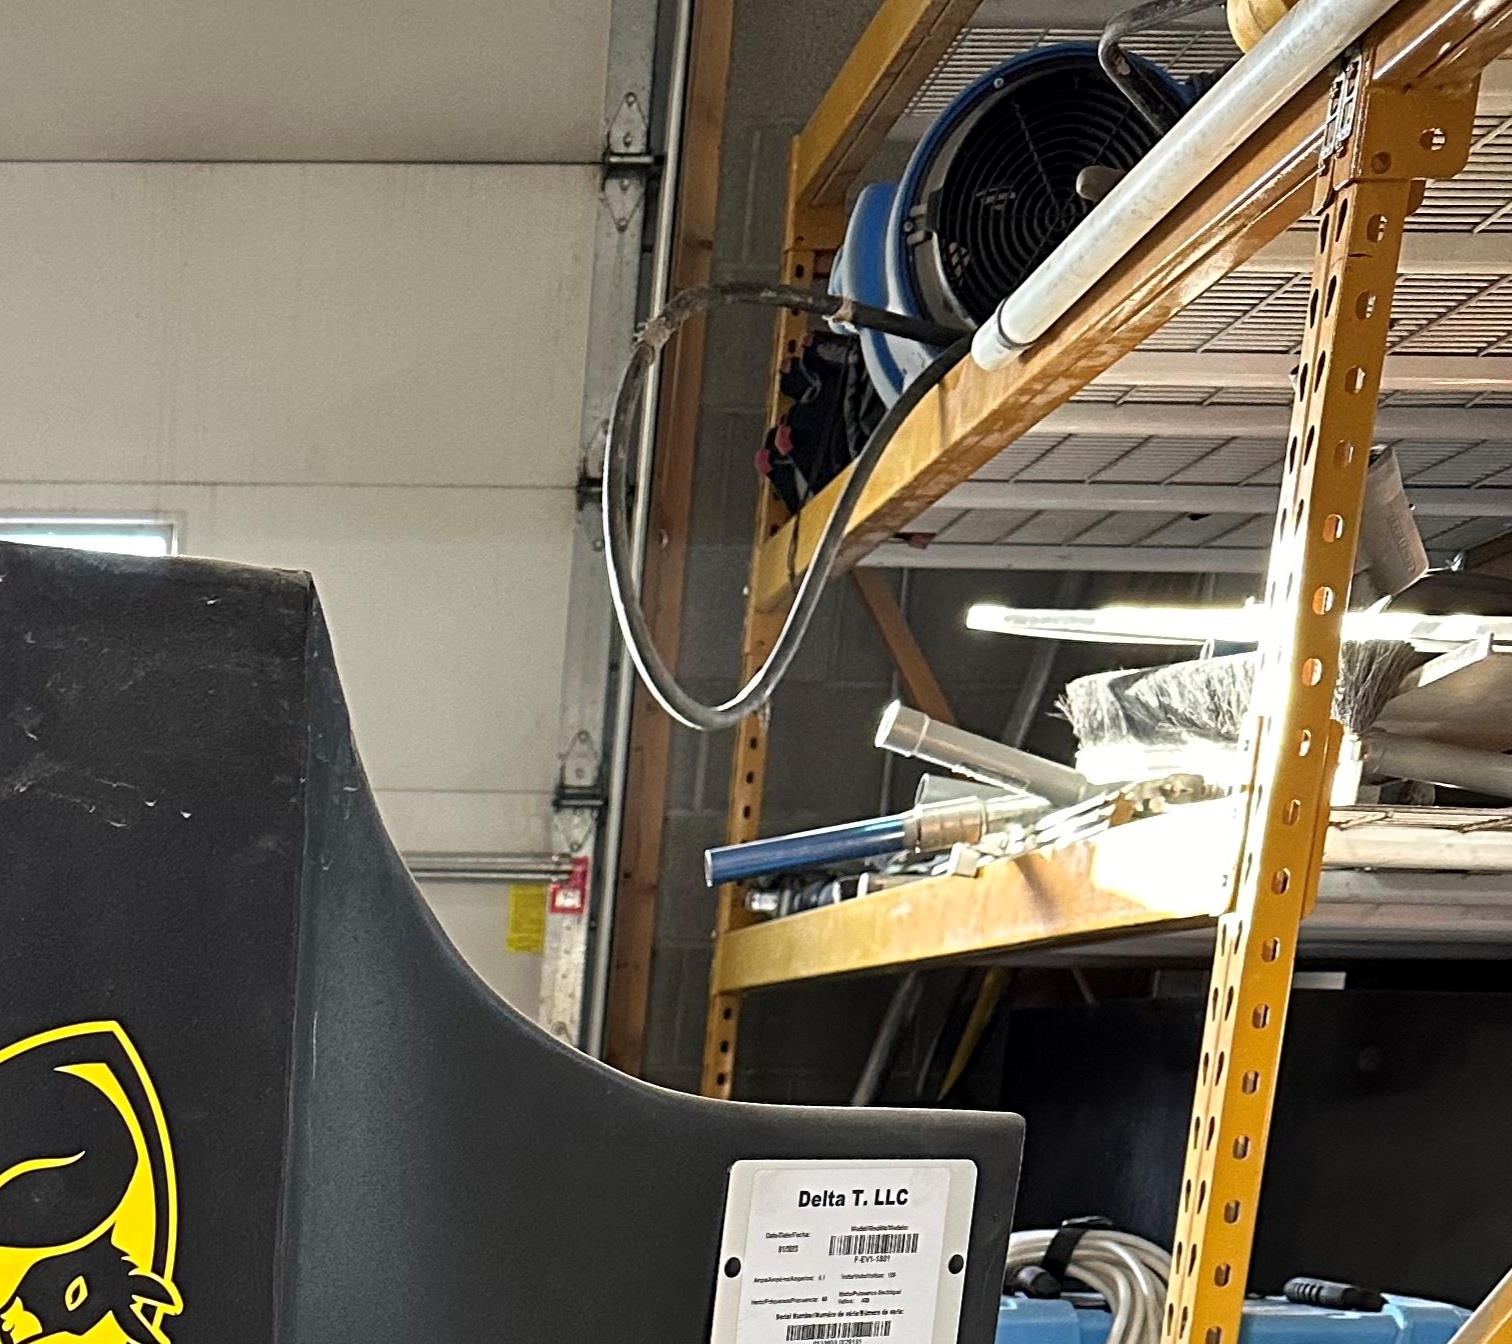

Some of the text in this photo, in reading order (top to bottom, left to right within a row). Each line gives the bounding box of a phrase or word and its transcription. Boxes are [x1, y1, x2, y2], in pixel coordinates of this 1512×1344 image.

[798, 1188, 909, 1207] Delta T. LLC
